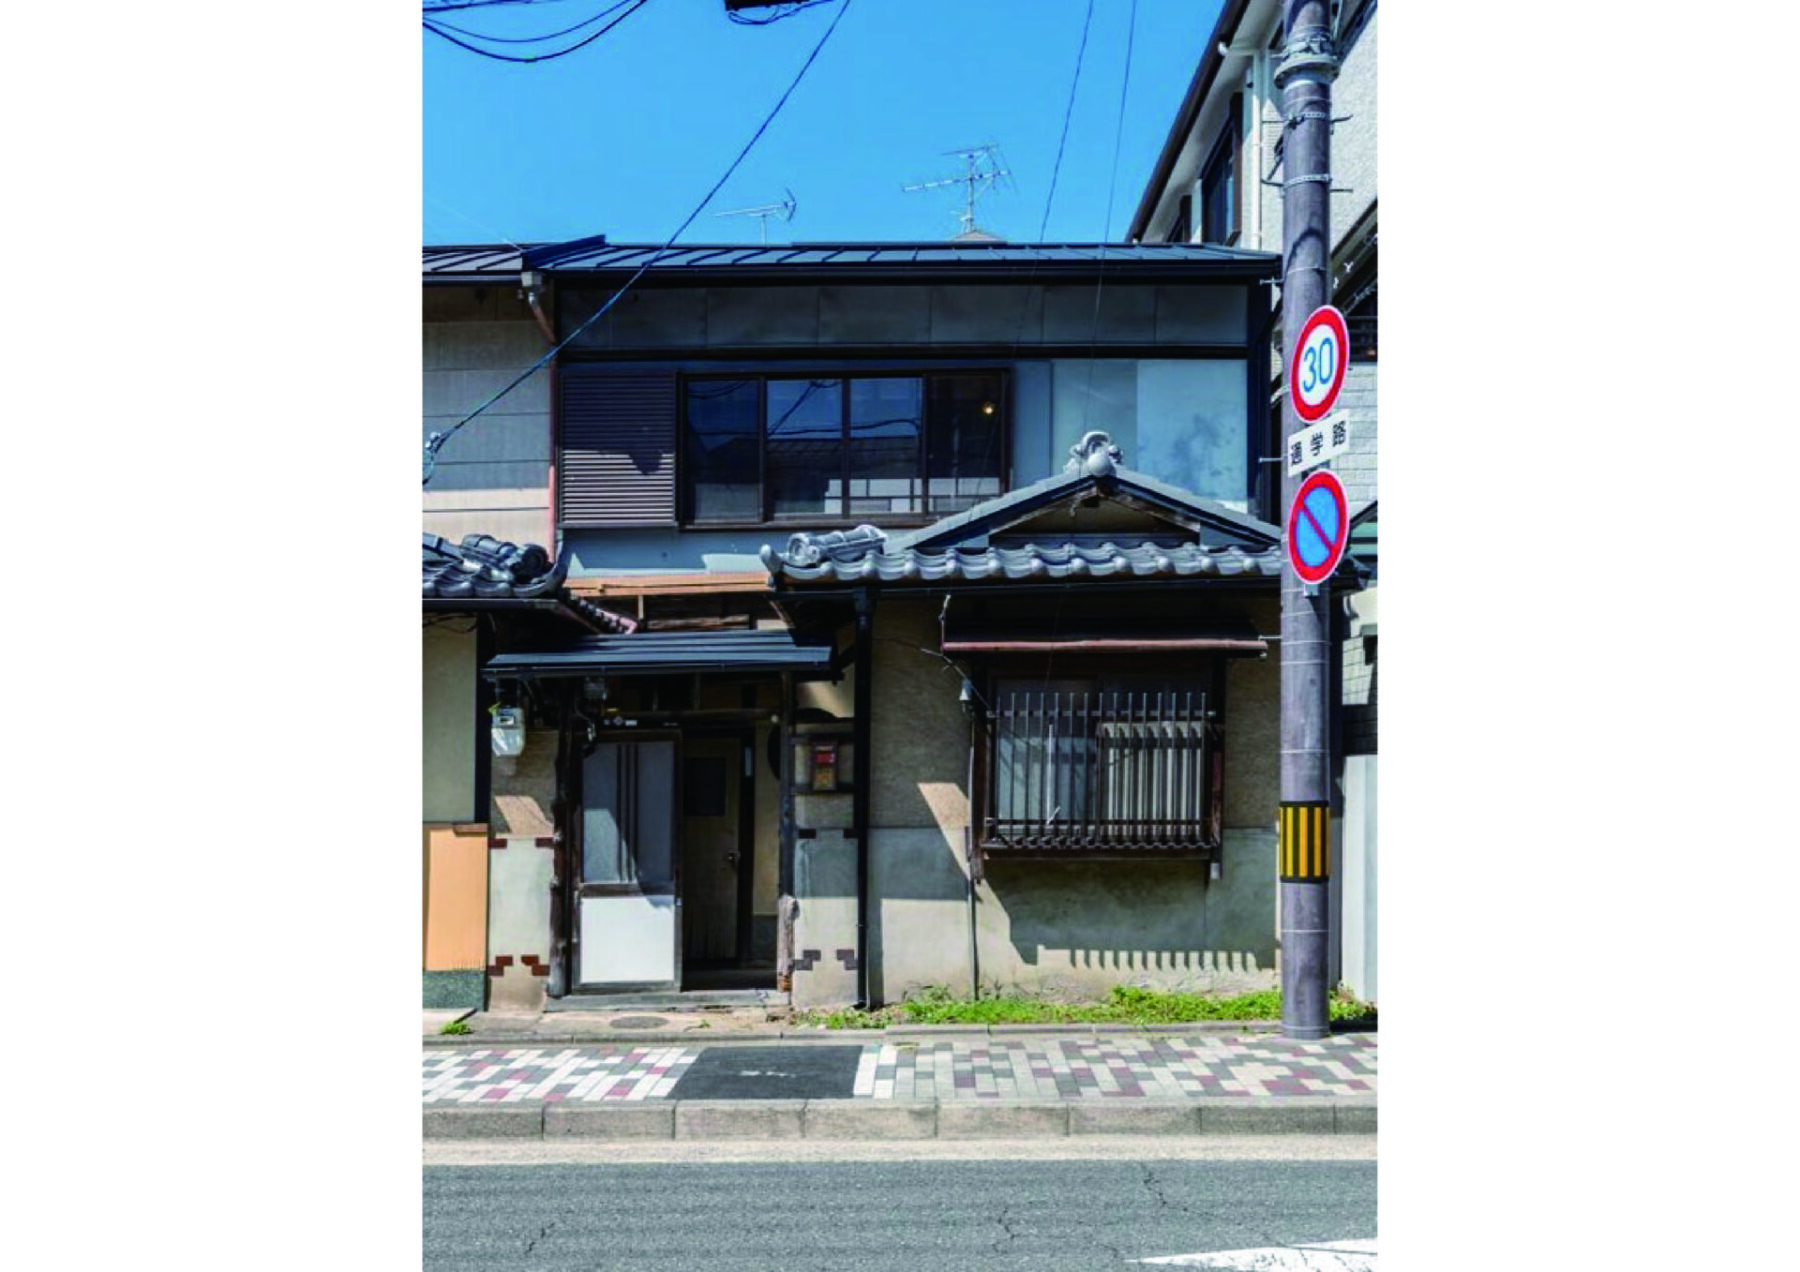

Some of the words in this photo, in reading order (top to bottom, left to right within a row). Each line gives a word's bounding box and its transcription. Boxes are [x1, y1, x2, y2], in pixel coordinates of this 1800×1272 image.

[1303, 338, 1333, 393] 30
[1291, 420, 1346, 465] 通学路
